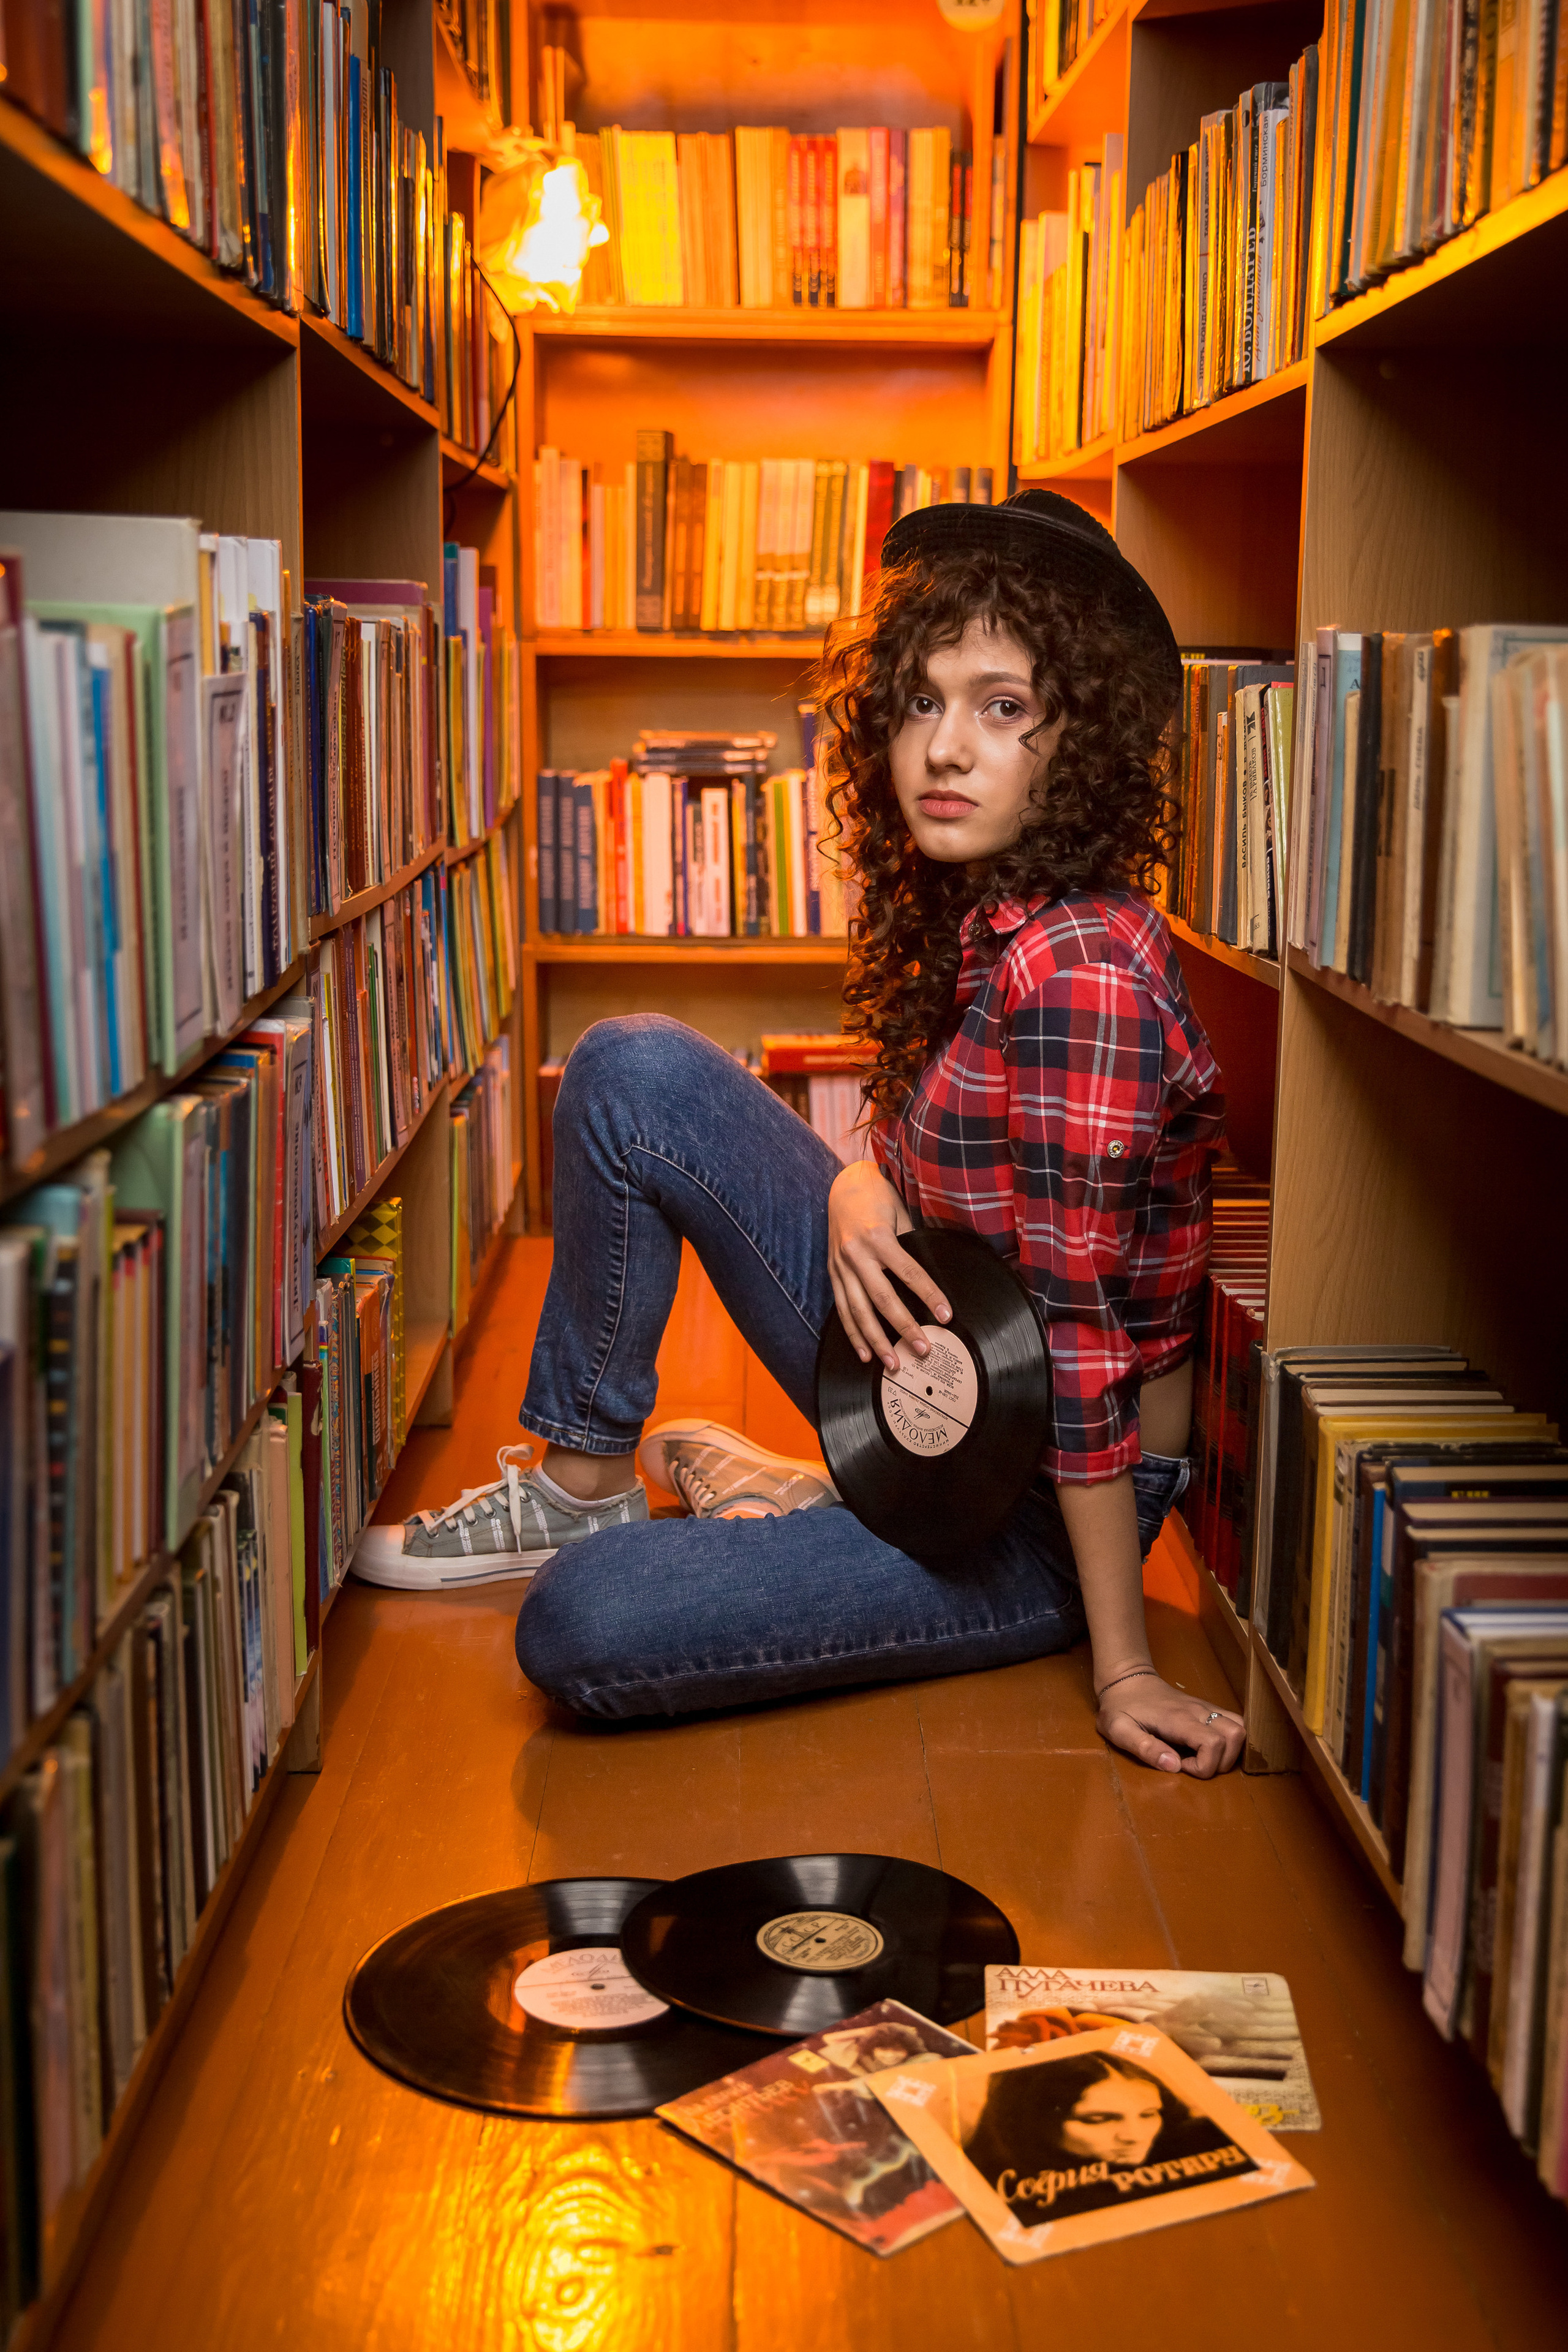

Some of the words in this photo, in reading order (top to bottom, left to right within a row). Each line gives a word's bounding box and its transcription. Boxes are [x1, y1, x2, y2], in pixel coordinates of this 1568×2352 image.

[1260, 116, 1268, 187] Борминская
[890, 1399, 948, 1444] МЕЛОДИЯ
[995, 1967, 1071, 1980] АЛЛА
[998, 1979, 1160, 1999] ПУГАЧЕВА
[997, 2162, 1109, 2207] София
[1110, 2145, 1246, 2193] РОТАРУ
